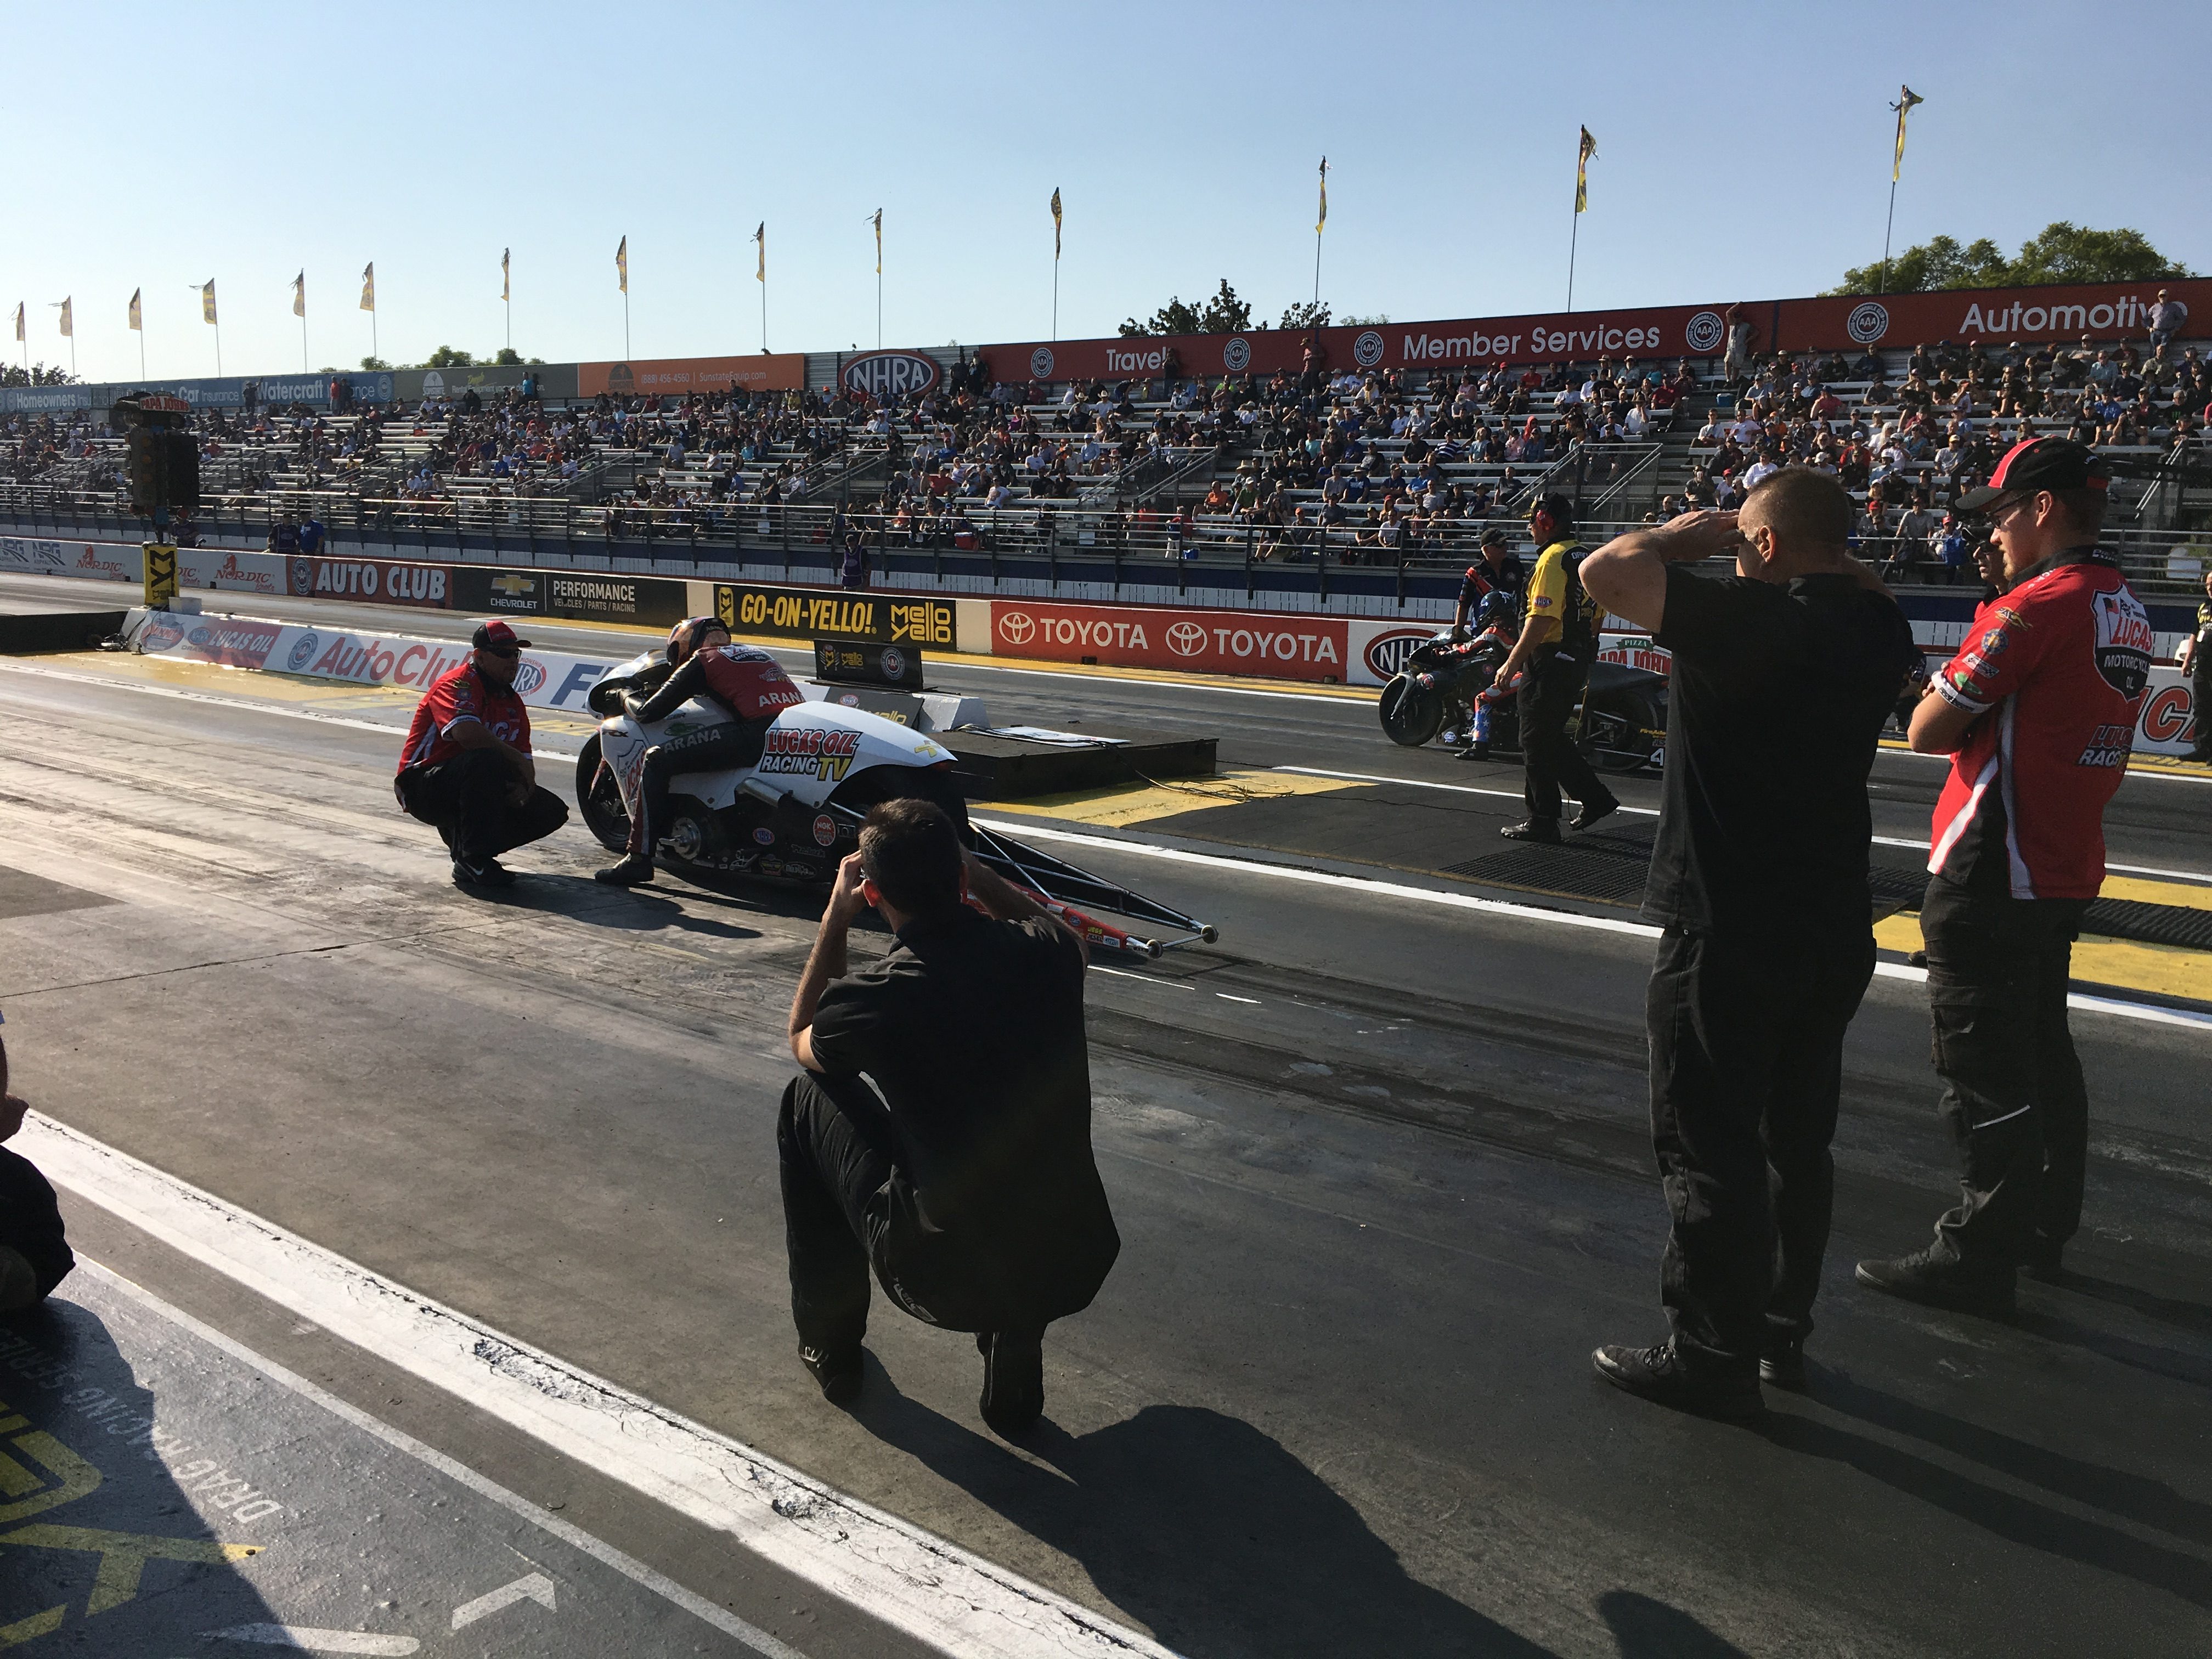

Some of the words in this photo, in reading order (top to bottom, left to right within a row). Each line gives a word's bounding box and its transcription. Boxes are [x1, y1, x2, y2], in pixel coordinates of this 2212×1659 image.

[1697, 326, 1712, 335] AAA
[1859, 317, 1876, 327] AAA
[1363, 343, 1375, 352] AAA
[1403, 331, 1521, 360] Member
[1531, 324, 1660, 354] Services
[1106, 346, 1166, 372] Travel
[1232, 349, 1243, 357] AAA
[641, 374, 657, 385] (888)
[659, 373, 690, 383] 456-4560
[853, 358, 925, 393] NHRA
[178, 386, 199, 403] Car
[201, 390, 240, 402] Insurance
[257, 379, 324, 400] Watercraft
[328, 385, 375, 399] Iance
[16, 393, 76, 409] Homeowners
[140, 398, 162, 410] PAPA
[76, 559, 123, 572] NORDIC
[214, 569, 272, 583] NORDIC
[315, 562, 379, 595] AUTO
[386, 566, 446, 600] CLUB
[553, 580, 636, 602] PERFORMANCE
[490, 598, 538, 609] CHEVROLET
[588, 601, 607, 611] PARTS
[613, 603, 635, 613] RACING
[741, 594, 873, 634] GO-ON-YELLO!
[190, 630, 208, 641] NHRA
[208, 630, 249, 650] LUCAS
[249, 635, 274, 653] OIL
[1040, 618, 1148, 650] TOYOTA
[1213, 629, 1338, 664] TOYOTA
[2111, 617, 2152, 652] LUCAS
[311, 636, 474, 687] AutoClu
[888, 659, 898, 667] AAA
[841, 695, 859, 704] NHRA
[664, 728, 721, 754] ARANA
[768, 730, 823, 755] LUCAS
[823, 731, 860, 755] OIL
[1650, 748, 1664, 766] 4
[761, 756, 819, 773] RACING
[817, 757, 850, 781] TV
[757, 831, 772, 840] NHRA
[1087, 926, 1103, 935] JEGS
[1087, 934, 1103, 942] JESEL
[62, 1386, 193, 1462] RACING
[172, 1459, 285, 1523] DRAG
